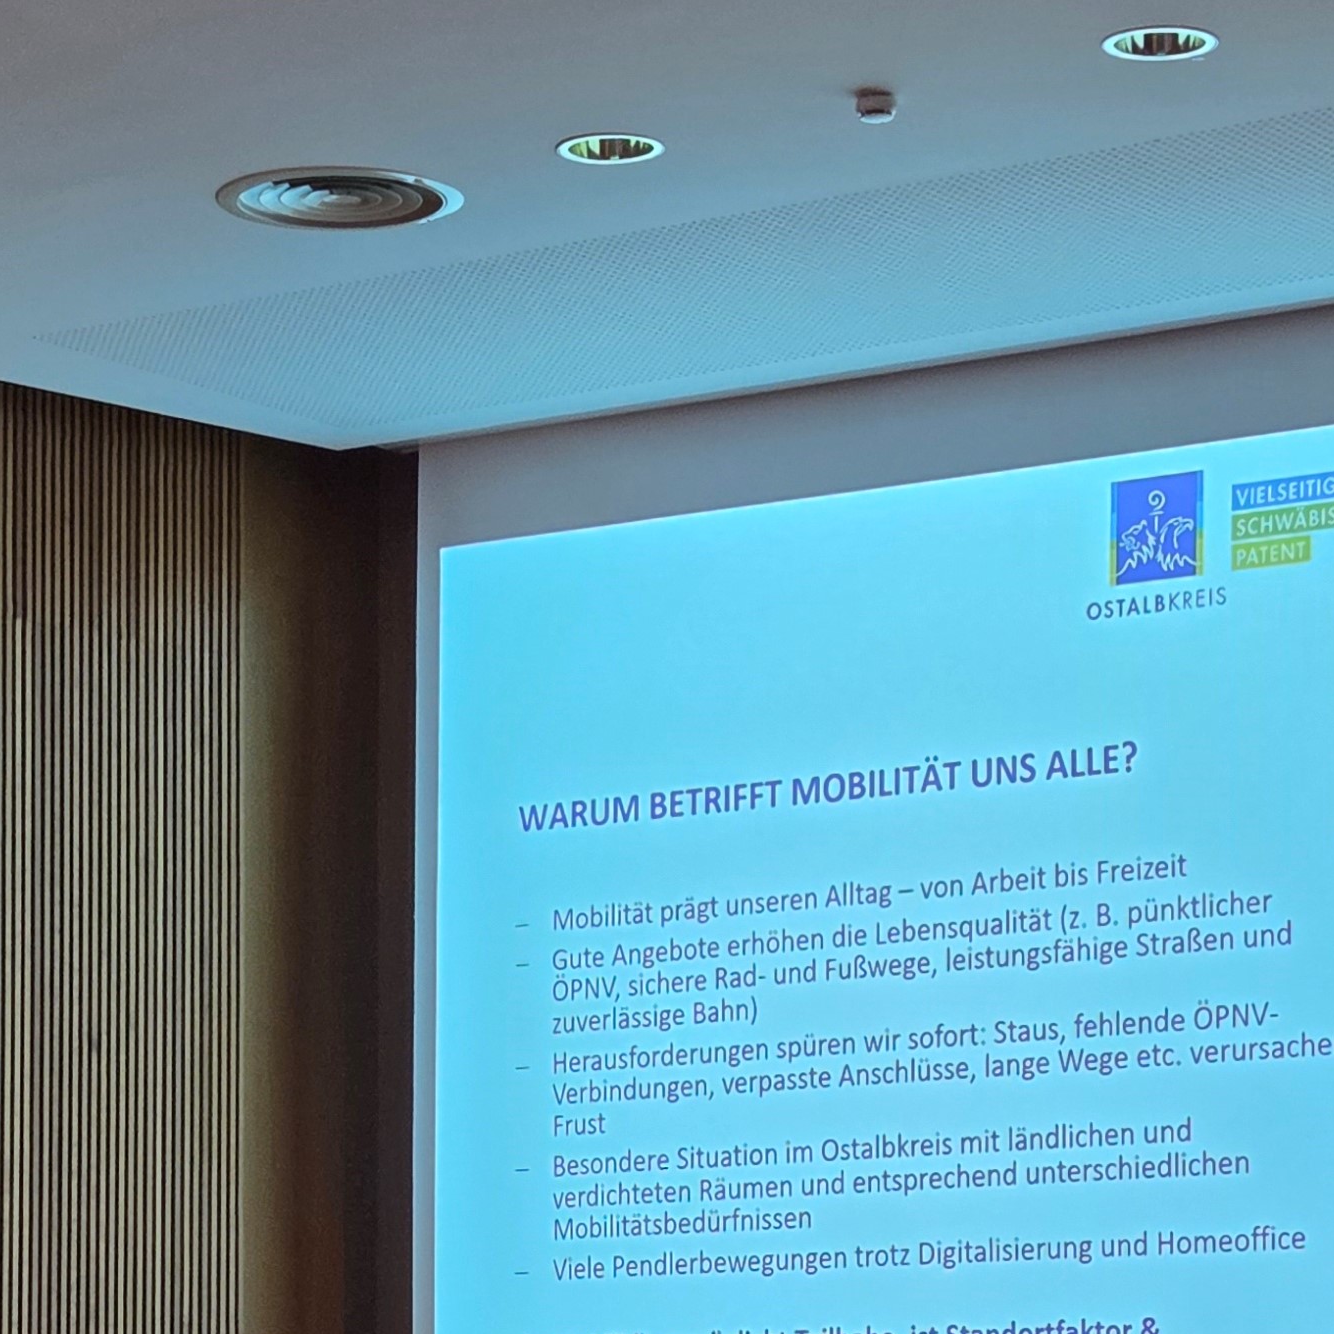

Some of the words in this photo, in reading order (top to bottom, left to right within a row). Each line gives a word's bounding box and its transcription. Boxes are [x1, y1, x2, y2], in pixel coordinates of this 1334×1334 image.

[1236, 541, 1307, 567] PATENT
[1086, 587, 1227, 621] OSTALBKREIS
[518, 793, 640, 833] WARUM
[649, 777, 783, 822] BETRIFFT
[791, 754, 963, 806] MOBILITÄT
[970, 751, 1037, 789] UNS
[1045, 739, 1138, 781] ALLE?
[552, 900, 654, 931] Mobilität
[660, 895, 720, 929] prägt
[725, 890, 818, 917] unseren
[823, 880, 893, 909] Alltag
[919, 878, 964, 900] von
[970, 865, 1047, 897] Arbeit
[1054, 861, 1089, 889] bis
[1096, 852, 1188, 885] Freizeit
[551, 946, 605, 971] Gute
[610, 936, 720, 970] Angebote
[726, 927, 824, 957] erhöhen
[831, 922, 868, 949] die
[875, 906, 1053, 946] Lebensqualität
[1059, 903, 1087, 936] (z.
[1096, 901, 1119, 928] B.
[1127, 889, 1274, 931] pünktlicher
[551, 974, 621, 1004] ÖPNV,
[627, 969, 708, 997] sichere
[714, 961, 767, 991] Rad-
[773, 957, 817, 986] und
[824, 953, 937, 982] Fußwege,
[945, 935, 1129, 973] leistungsfähige
[1135, 925, 1234, 958] Straßen
[1242, 918, 1292, 949] und
[551, 1003, 686, 1035] zuverlässige
[692, 994, 758, 1026] Bahn)
[552, 1040, 769, 1075] Herausforderungen
[775, 1032, 856, 1064] spüren
[862, 1027, 902, 1054] wir
[906, 1022, 987, 1051] sofort:
[992, 1019, 1066, 1046] Staus,
[1072, 1005, 1186, 1040] fehlende
[1193, 1000, 1279, 1031] ÖPNV-
[551, 1075, 715, 1106] Verbindungen,
[720, 1066, 832, 1099] verpasste
[837, 1056, 976, 1089] Anschlüsse,
[984, 1051, 1051, 1082] lange
[1056, 1047, 1129, 1077] Wege
[1135, 1043, 1182, 1069] etc.
[552, 1147, 670, 1178] Besondere
[675, 1142, 778, 1170] Situation
[785, 1139, 814, 1165] im
[820, 1131, 953, 1162] Ostalbkreis
[959, 1128, 1001, 1156] mit
[1007, 1121, 1135, 1152] ländlichen
[1142, 1115, 1192, 1145] und
[553, 1111, 606, 1138] Frust
[552, 1180, 691, 1210] verdichteten
[698, 1176, 793, 1202] Räumen
[800, 1168, 845, 1197] und
[851, 1158, 1017, 1197] entsprechend
[1025, 1149, 1250, 1186] unterschiedlichen
[552, 1254, 606, 1281] Viele
[612, 1248, 848, 1279] Pendlerbewegungen
[853, 1243, 911, 1269] trotz
[918, 1236, 1093, 1270] Digitalisierung
[1100, 1229, 1148, 1258] und
[1157, 1224, 1306, 1256] Homeoffice
[553, 1206, 812, 1241] Mobilitätsbedürfnissen
